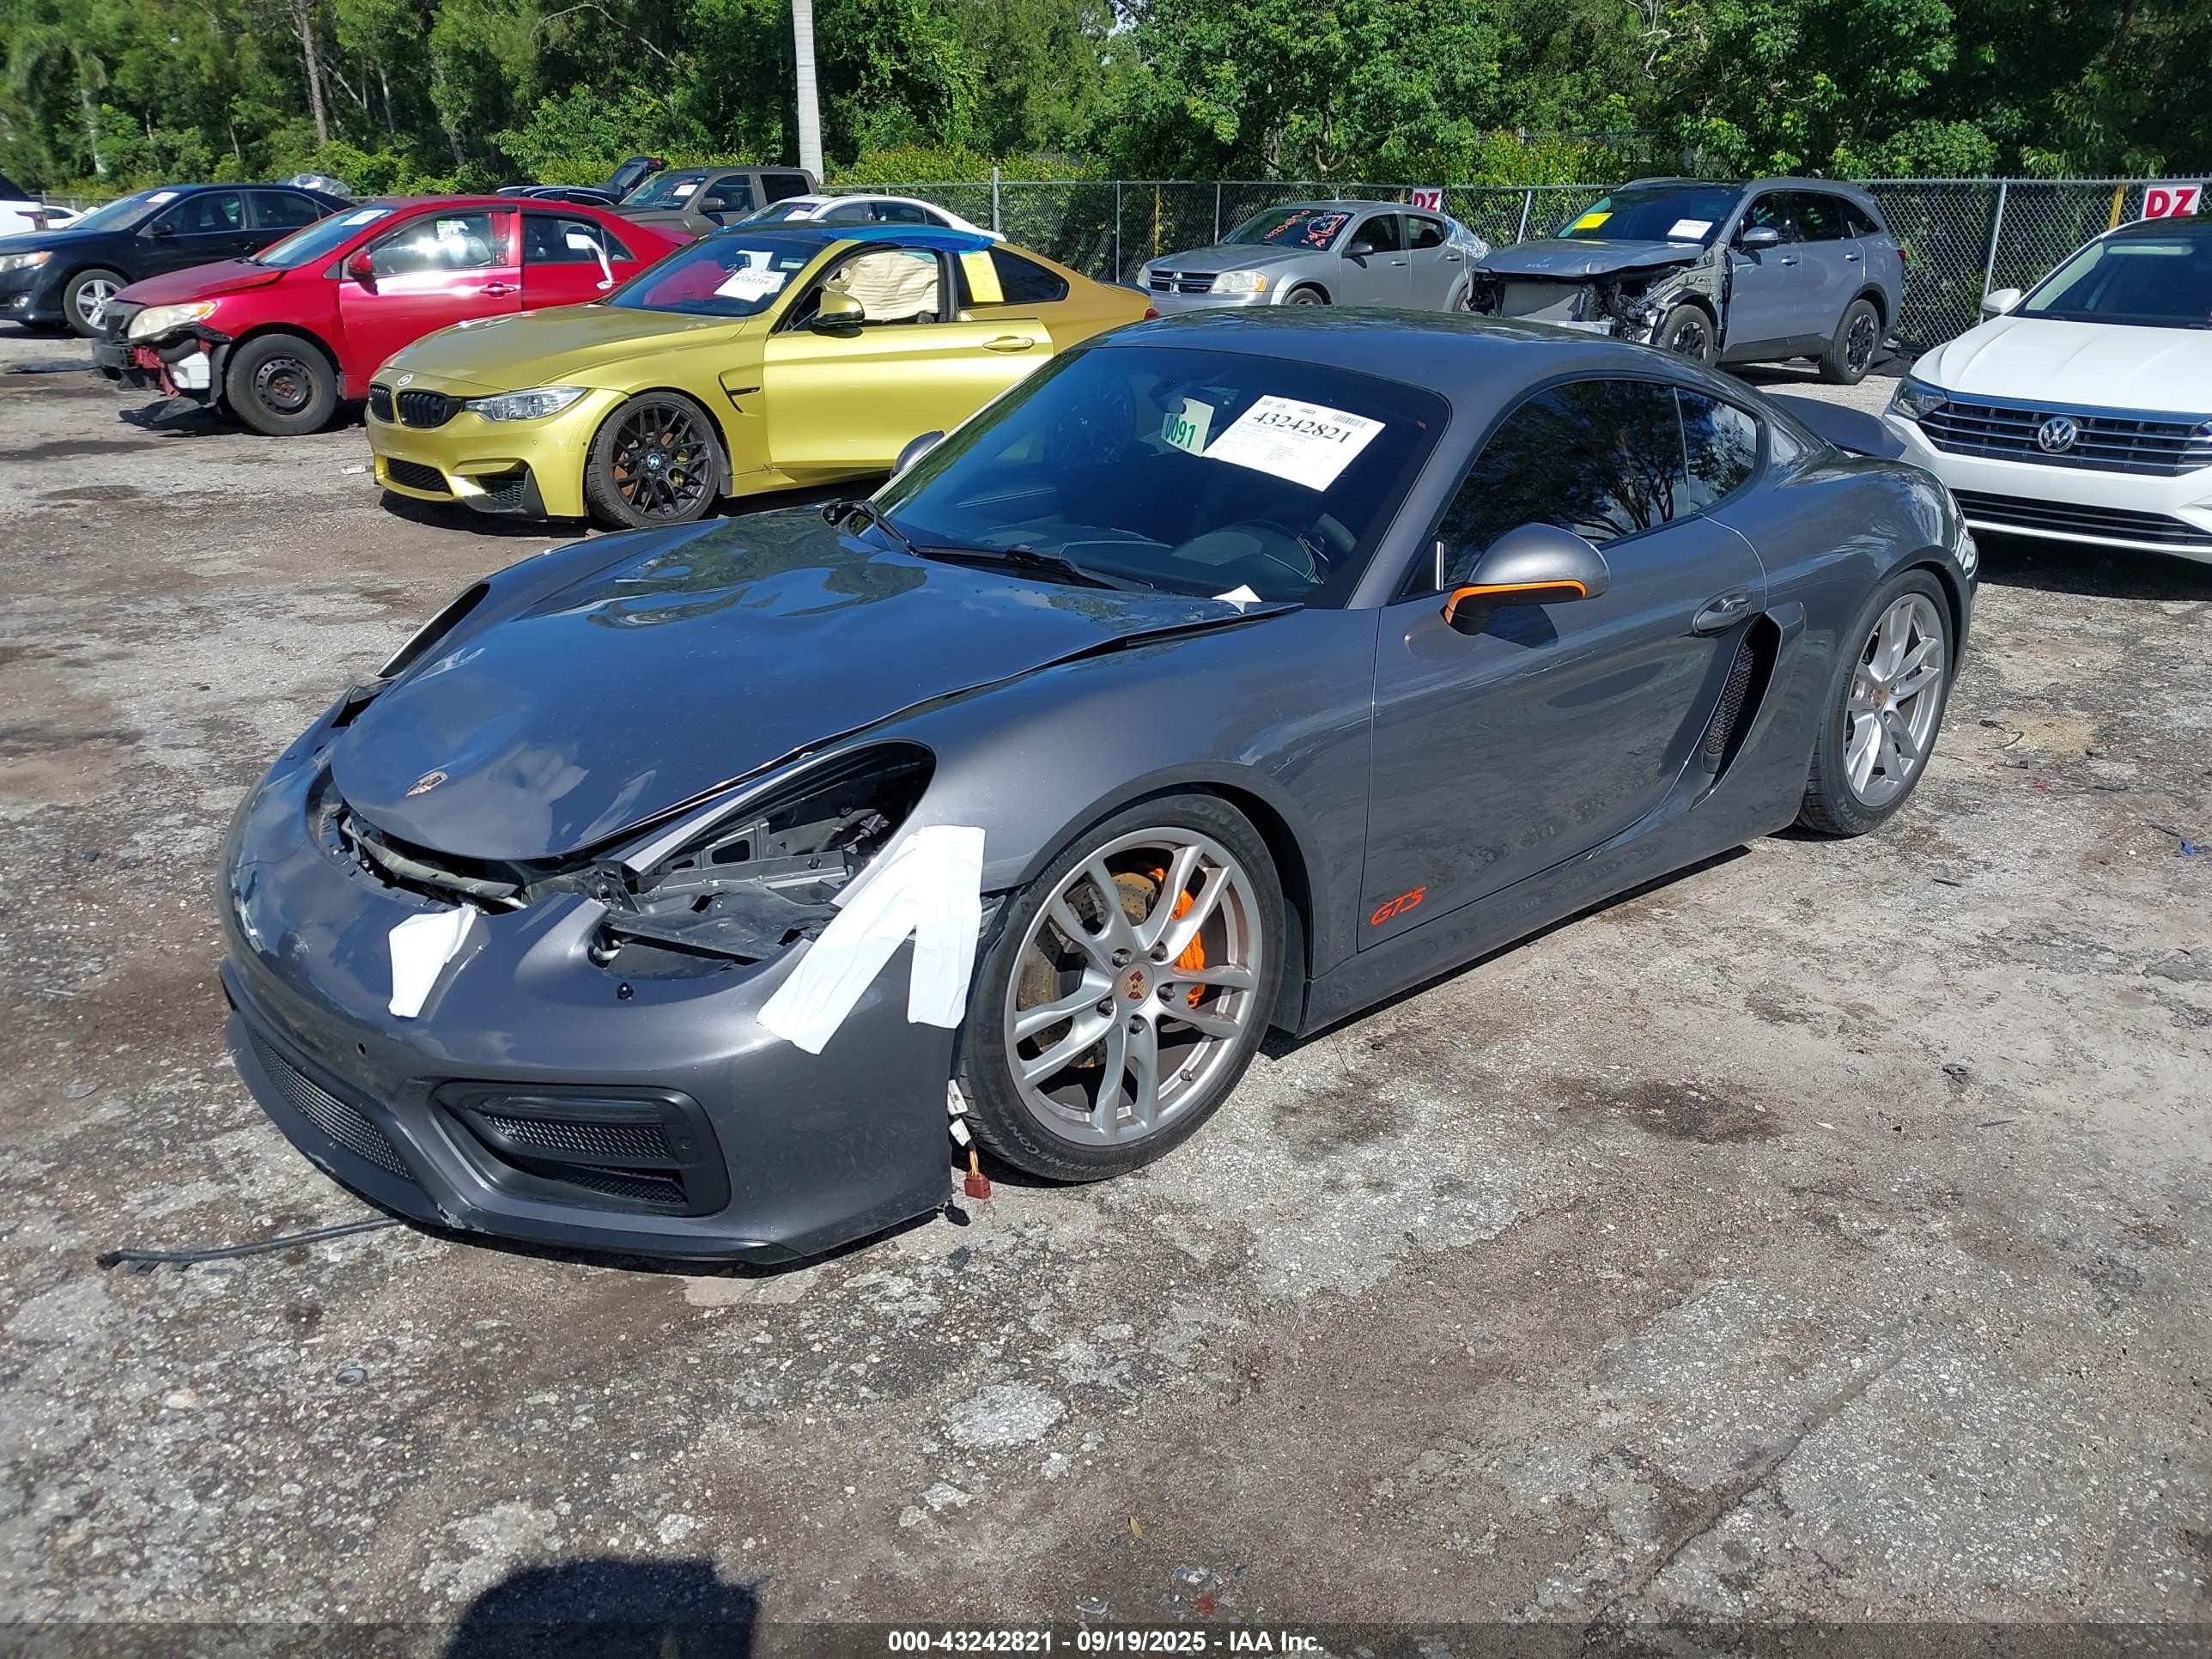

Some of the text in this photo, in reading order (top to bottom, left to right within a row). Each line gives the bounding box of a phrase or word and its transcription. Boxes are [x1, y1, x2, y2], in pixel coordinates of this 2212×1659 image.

[1413, 191, 1440, 212] DZ
[2145, 188, 2199, 218] DZ
[1165, 416, 1196, 449] 0091
[1253, 411, 1352, 444] 43242821
[1371, 885, 1426, 925] GTS
